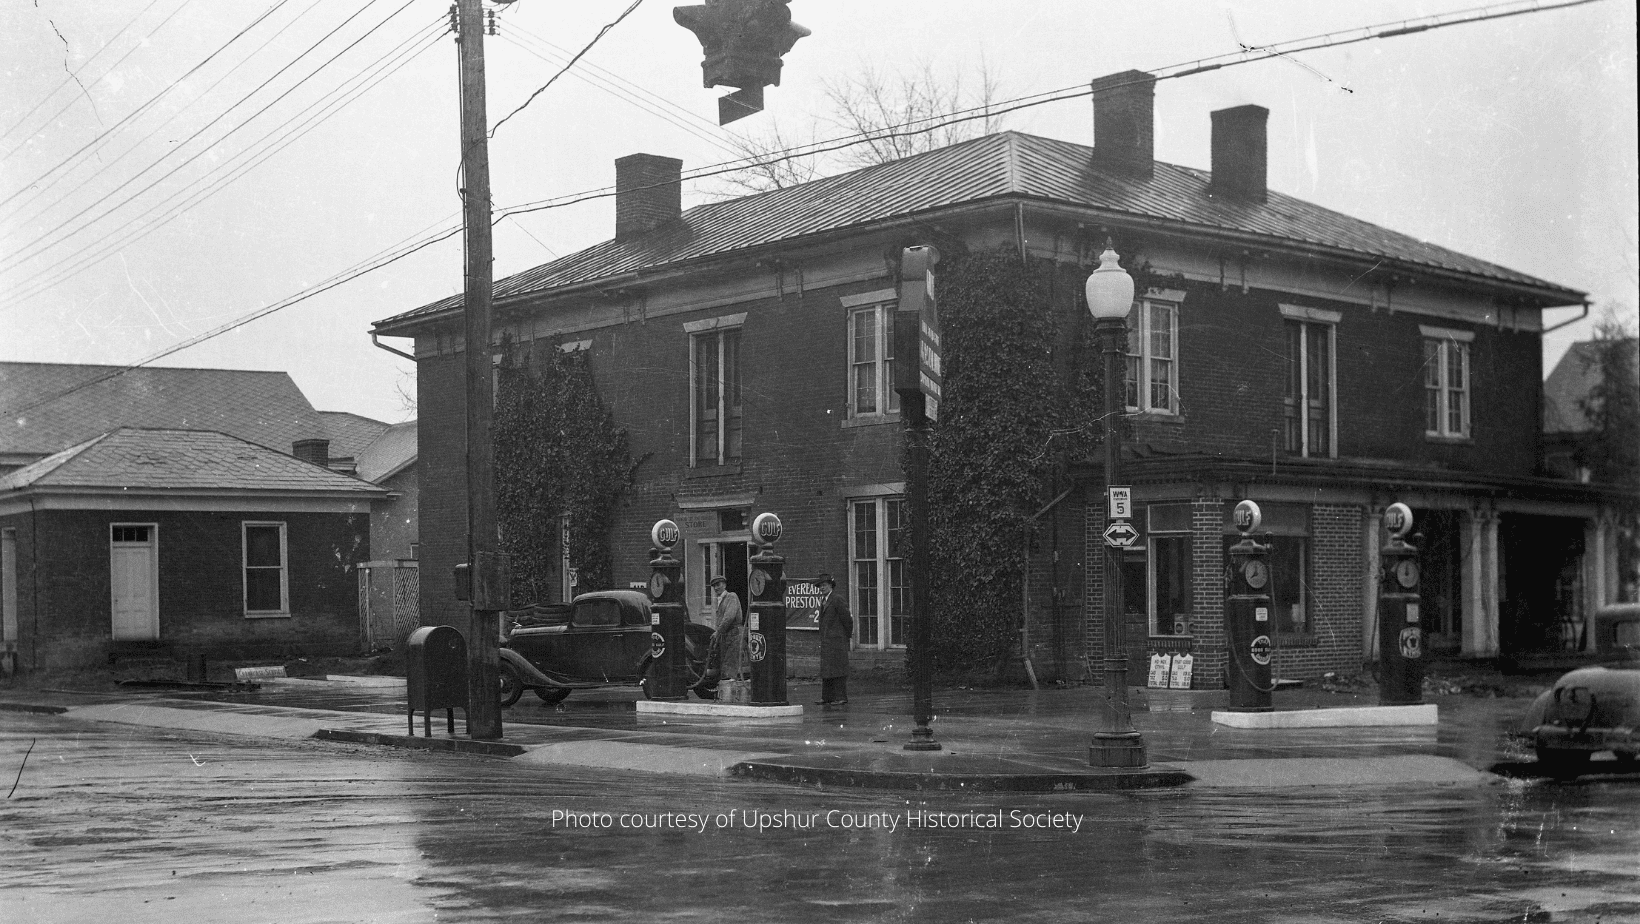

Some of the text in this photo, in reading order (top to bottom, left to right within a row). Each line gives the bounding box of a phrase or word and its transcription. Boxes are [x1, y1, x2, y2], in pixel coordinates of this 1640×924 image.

[1116, 502, 1125, 515] 5
[684, 521, 707, 529] STORE
[761, 521, 781, 537] GULF
[659, 527, 678, 542] GULF
[788, 582, 823, 595] EVEREAD
[785, 596, 824, 609] PRESTON
